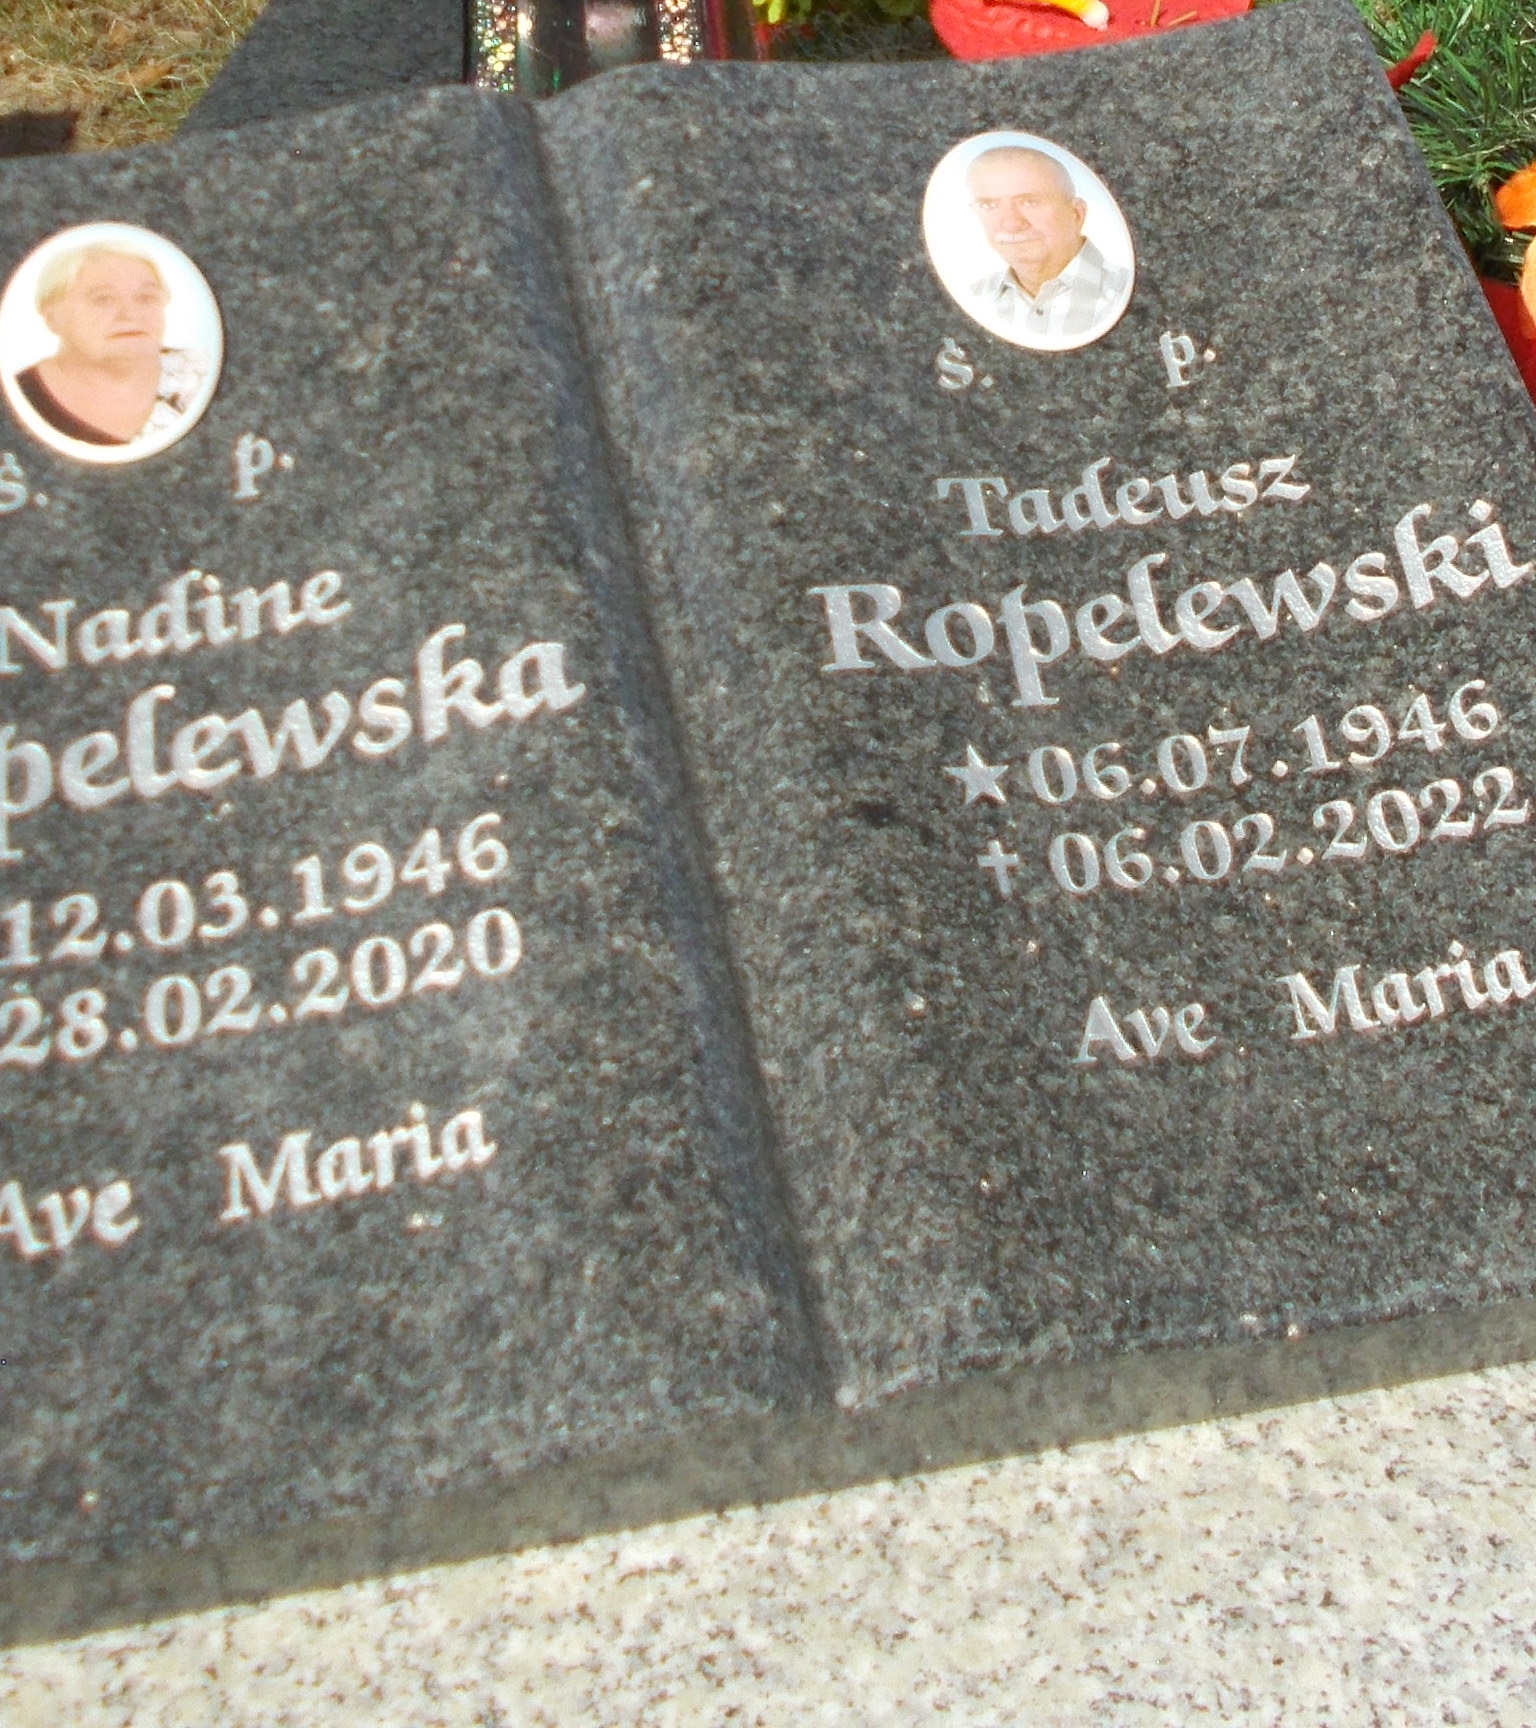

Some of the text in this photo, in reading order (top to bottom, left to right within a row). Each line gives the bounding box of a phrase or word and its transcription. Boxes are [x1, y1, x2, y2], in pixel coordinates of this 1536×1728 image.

[937, 453, 1310, 538] Tadeusz
[808, 498, 1535, 708] Ropelewski
[1028, 678, 1500, 804] 06.07.1946
[1050, 766, 1530, 895] 06.02.2022
[1073, 995, 1217, 1065] Ave
[219, 1102, 497, 1221] Maria
